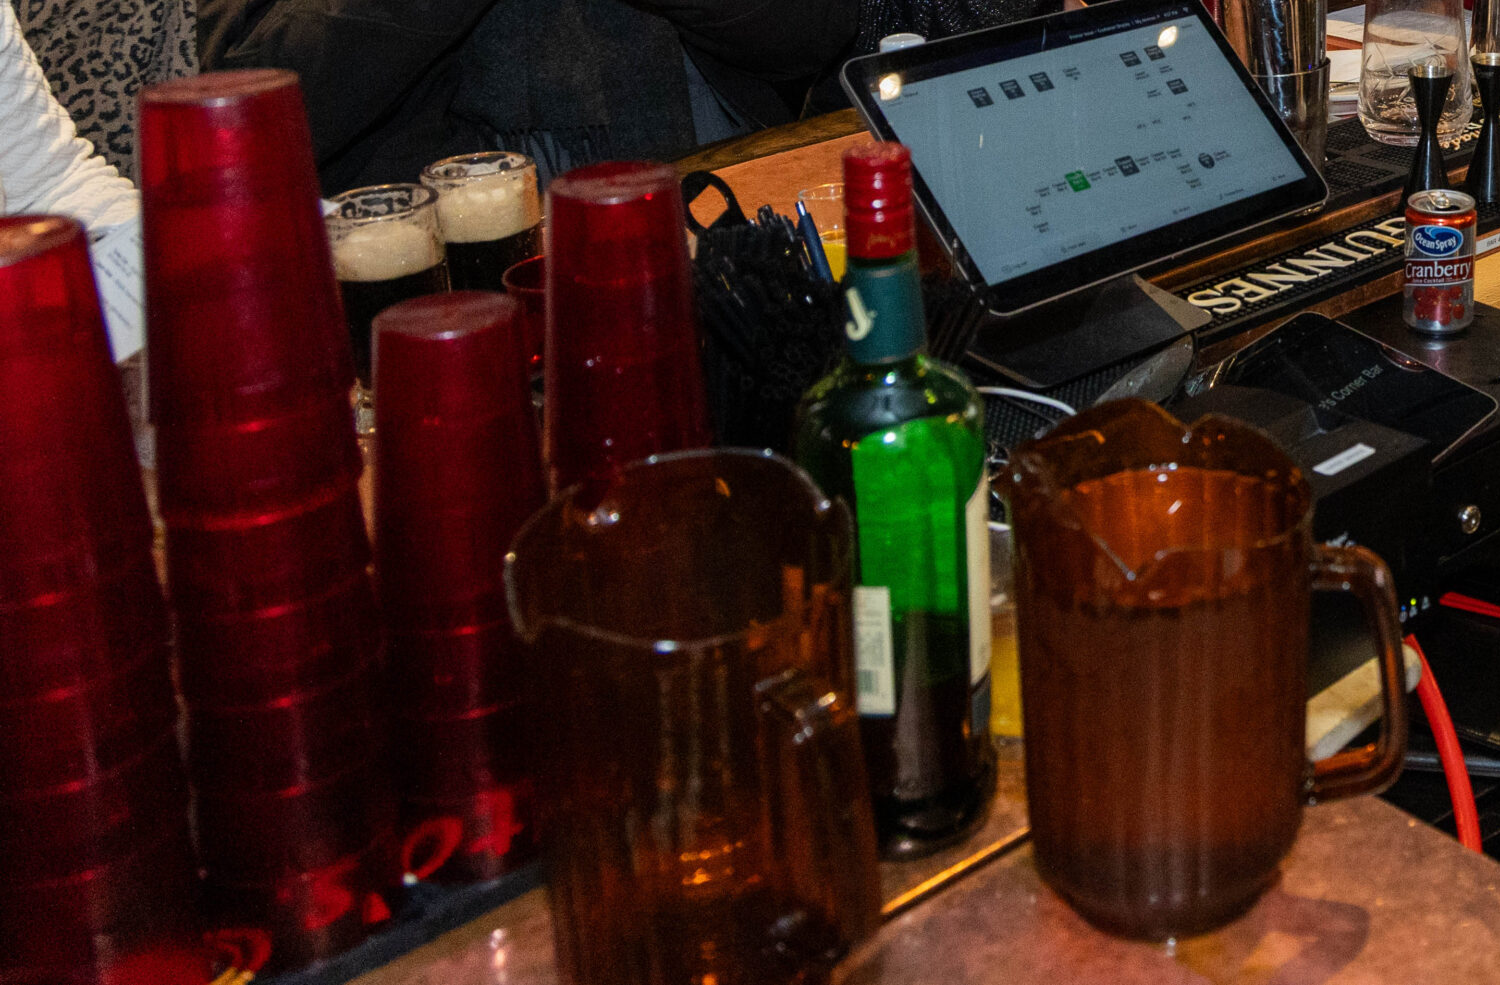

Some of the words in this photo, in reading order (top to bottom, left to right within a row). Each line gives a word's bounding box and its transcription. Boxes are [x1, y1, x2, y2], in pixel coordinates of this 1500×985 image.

[1415, 232, 1435, 249] Ocean
[1435, 236, 1457, 251] Spray
[1187, 216, 1406, 316] UINNES
[1405, 261, 1472, 280] Cranberry
[1331, 376, 1368, 400] Corner
[1362, 364, 1384, 379] Bar
